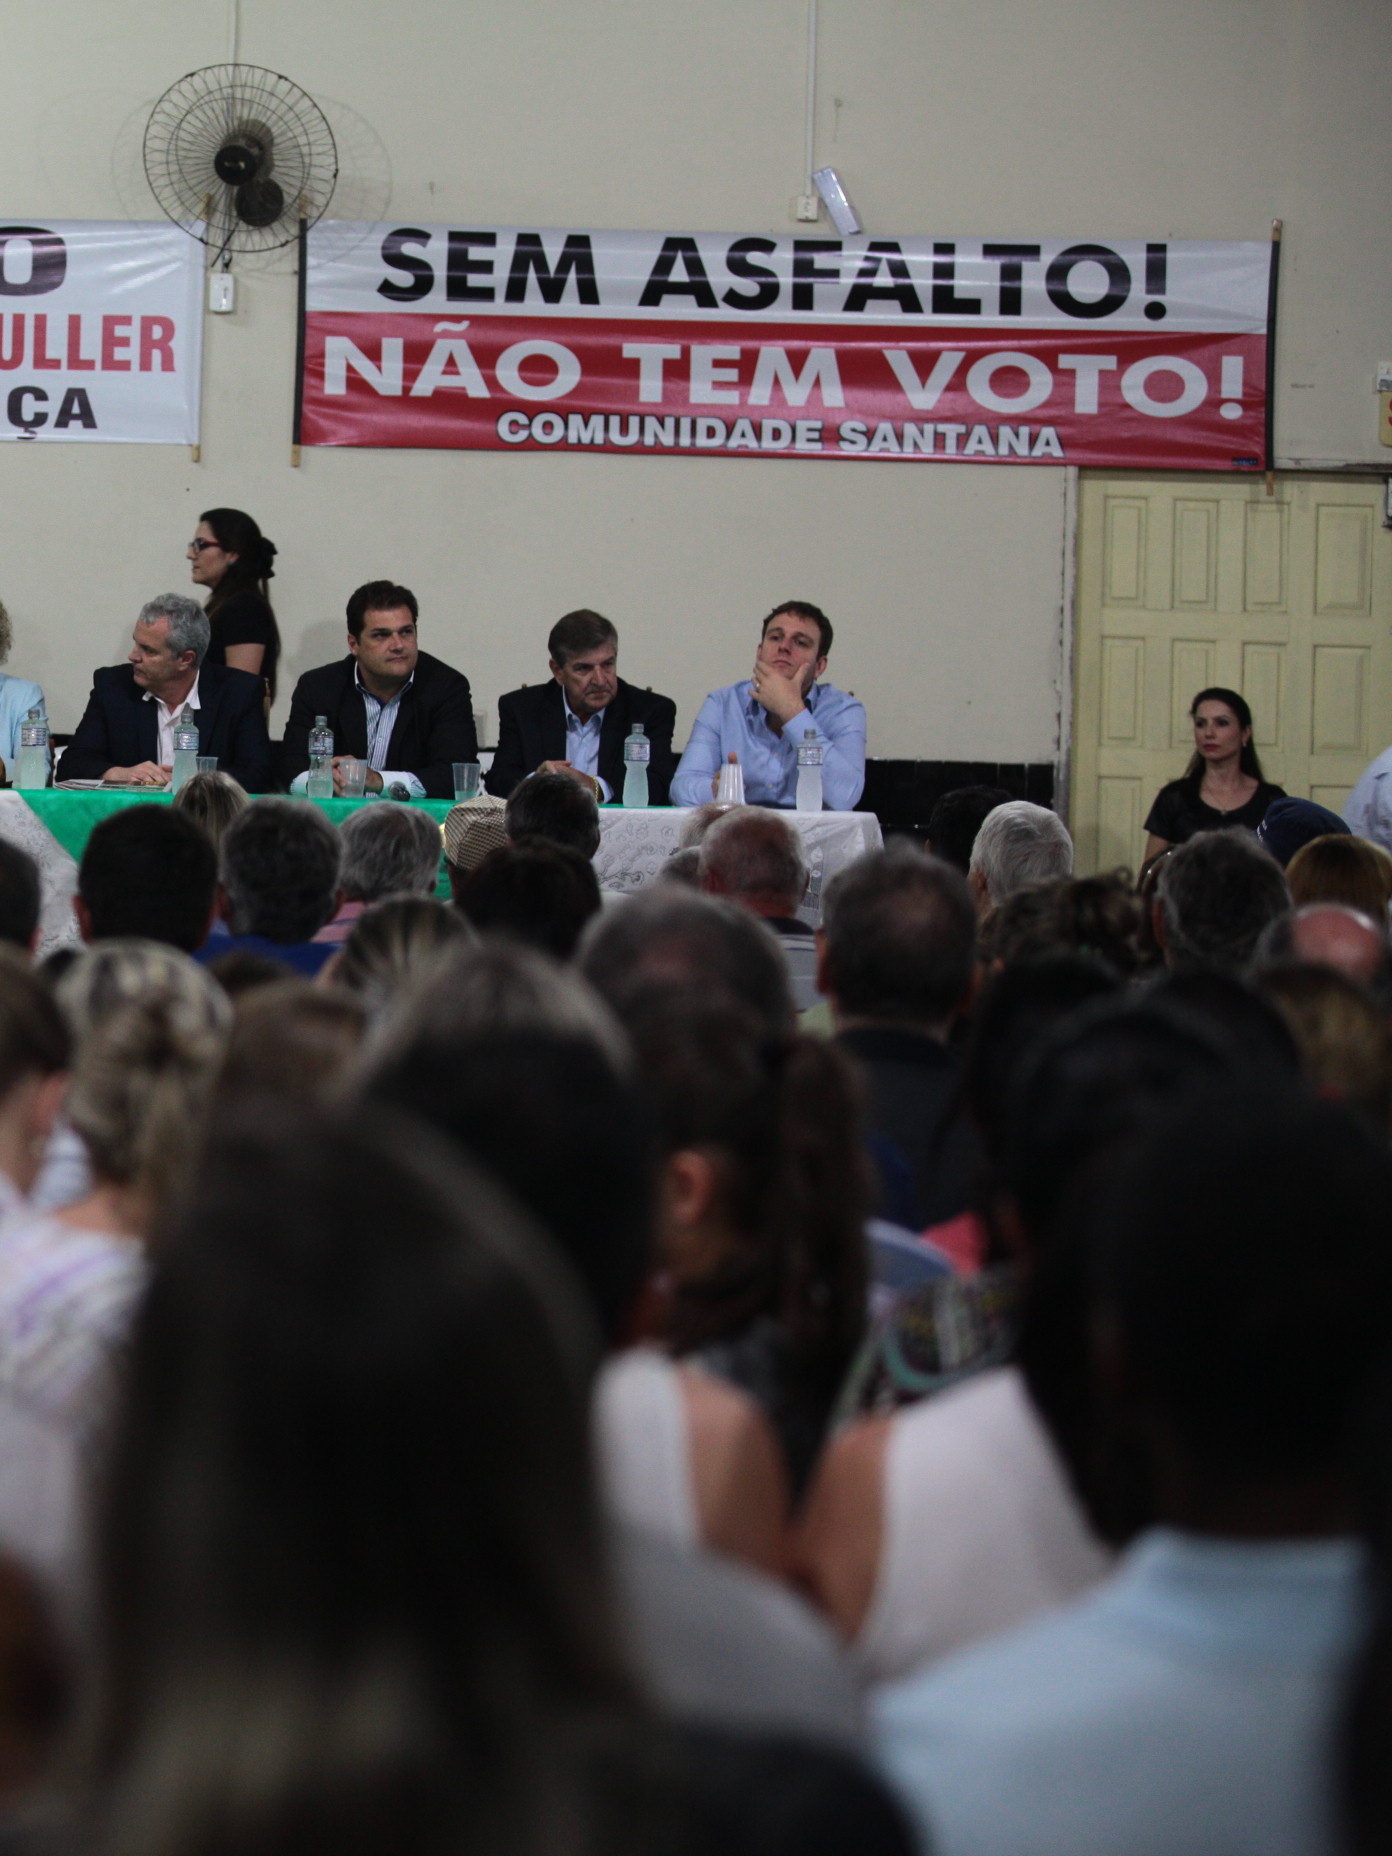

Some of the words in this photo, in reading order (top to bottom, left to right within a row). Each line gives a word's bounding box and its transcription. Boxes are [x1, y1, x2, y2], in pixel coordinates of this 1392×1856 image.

[376, 228, 601, 306] SEM
[637, 236, 1168, 321] ASFALTO!
[324, 320, 582, 401] NÃO
[622, 343, 845, 408] TEM
[882, 350, 1244, 420] VOTO!
[495, 410, 825, 452] COMUNIDADE
[838, 418, 1067, 459] SANTANA
